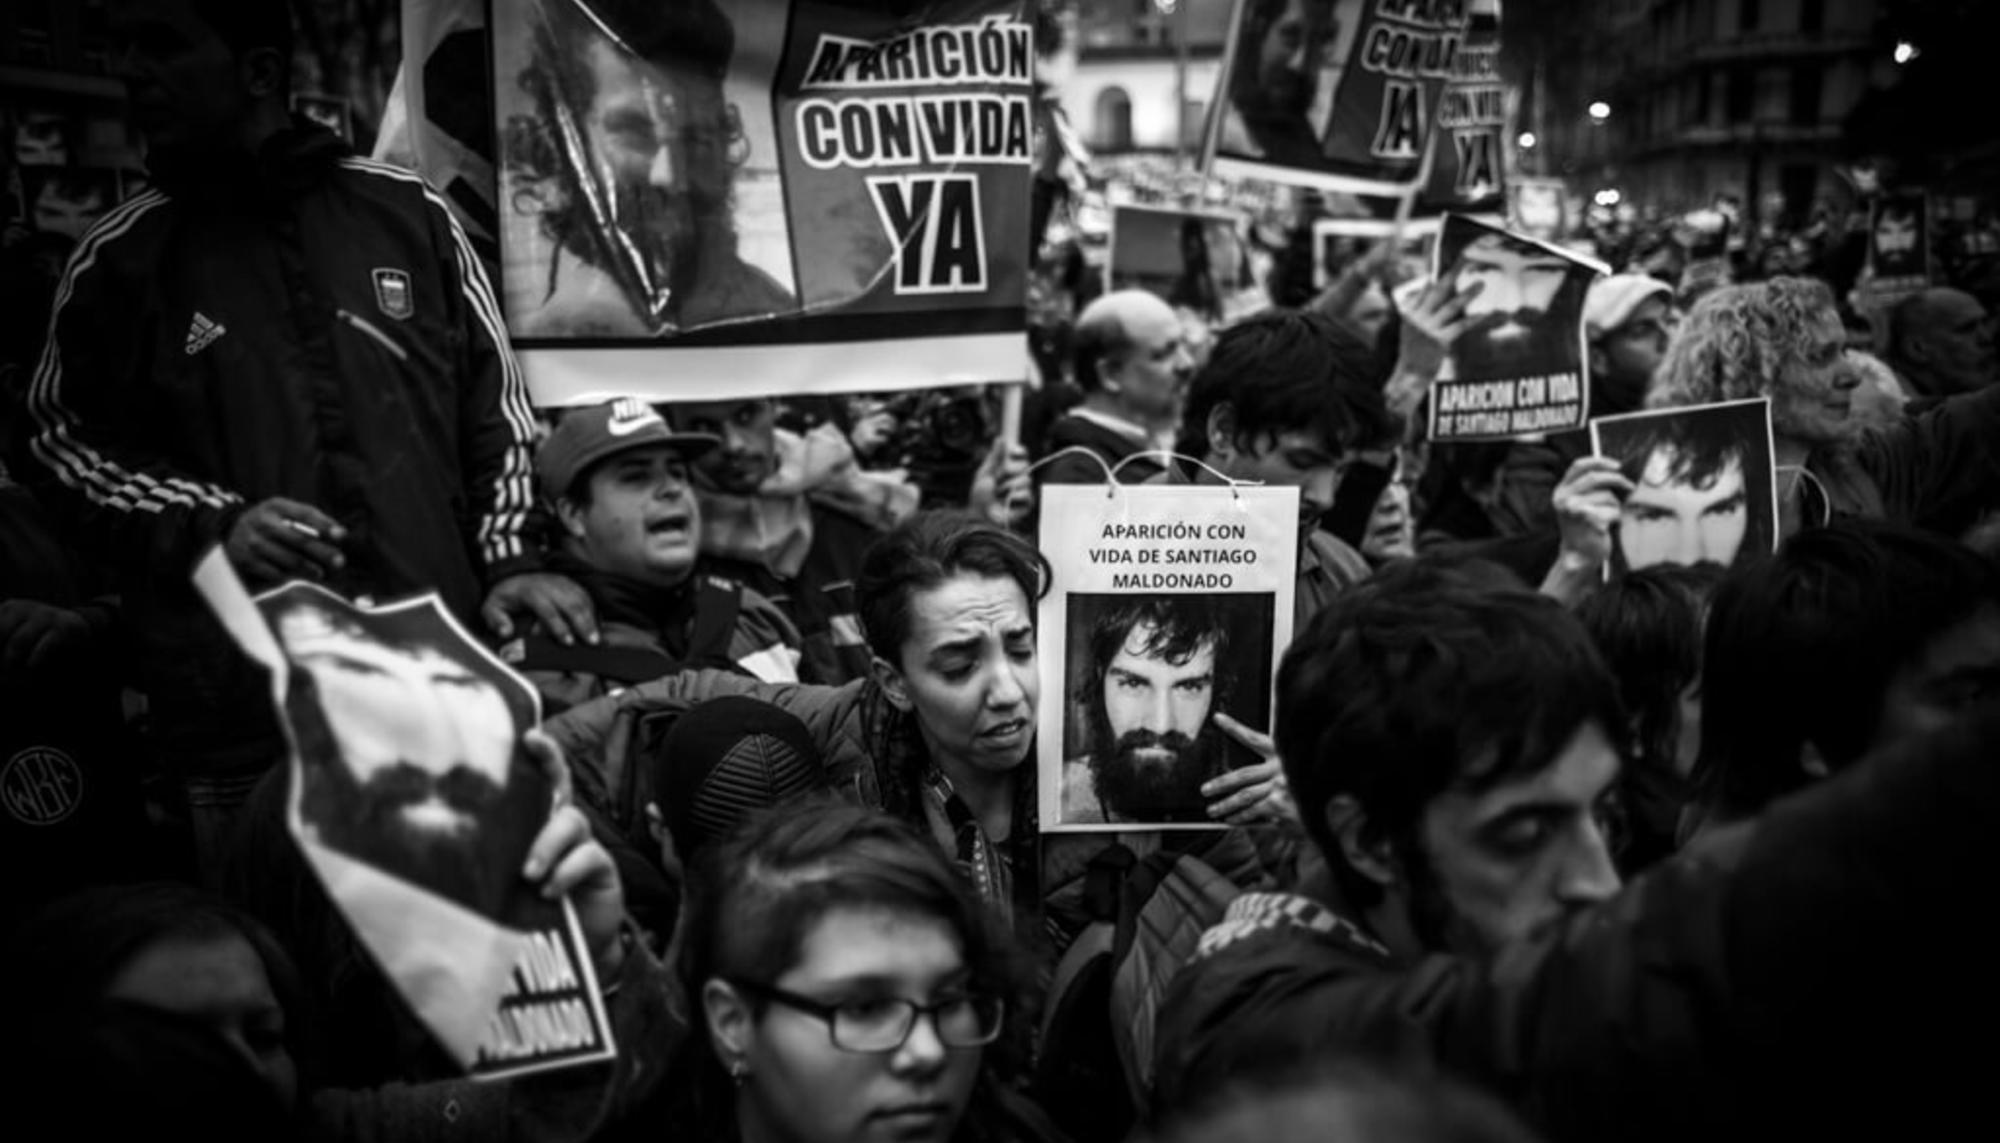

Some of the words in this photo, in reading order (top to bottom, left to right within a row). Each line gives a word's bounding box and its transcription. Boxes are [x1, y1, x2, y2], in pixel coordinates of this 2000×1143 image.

[802, 16, 1031, 88] APARICIÓN
[798, 95, 914, 166] CON
[917, 94, 1031, 164] VIDA
[867, 173, 988, 295] YA
[1517, 376, 1545, 406] CON
[1548, 372, 1579, 403] VIDA
[1455, 410, 1510, 435] SANTIAGO
[1512, 404, 1579, 431] MALDONADO
[1102, 522, 1201, 540] APARICIÓN
[1206, 524, 1245, 540] CON
[1089, 549, 1133, 564] VIDA
[1138, 549, 1159, 564] DE
[1164, 549, 1257, 564] SANTIAGO
[1112, 573, 1233, 588] MALDONADO
[471, 998, 595, 1060] ALDONADO
